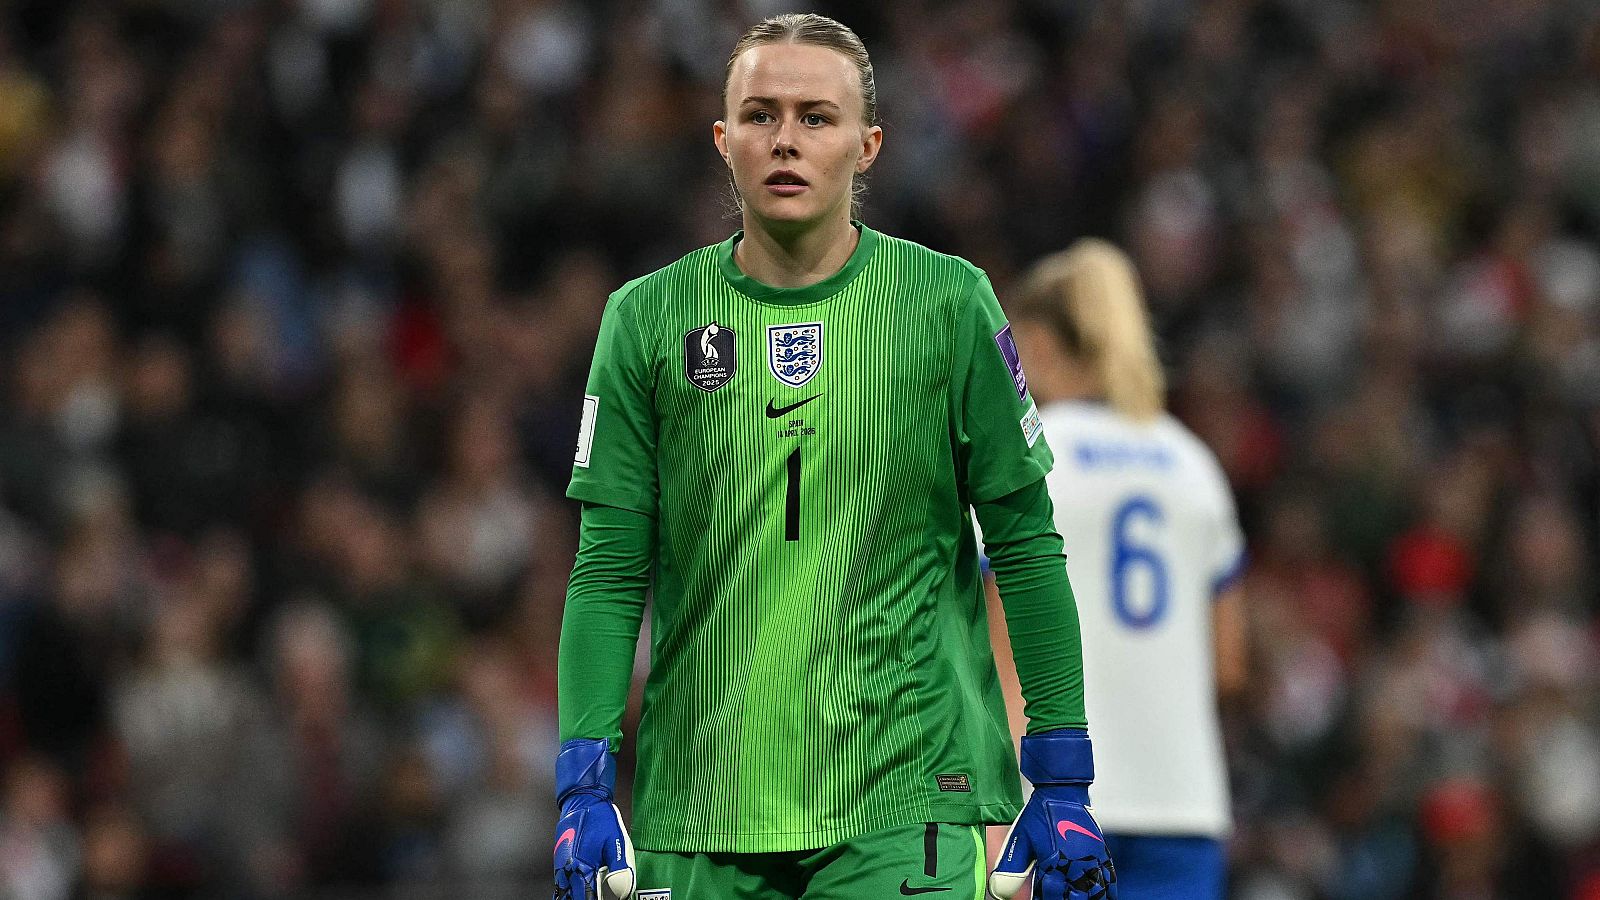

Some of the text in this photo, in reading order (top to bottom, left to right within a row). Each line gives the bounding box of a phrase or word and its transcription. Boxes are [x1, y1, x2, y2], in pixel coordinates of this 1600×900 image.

[788, 419, 803, 428] SPAIN
[785, 446, 801, 541] 1
[1109, 495, 1170, 629] 6
